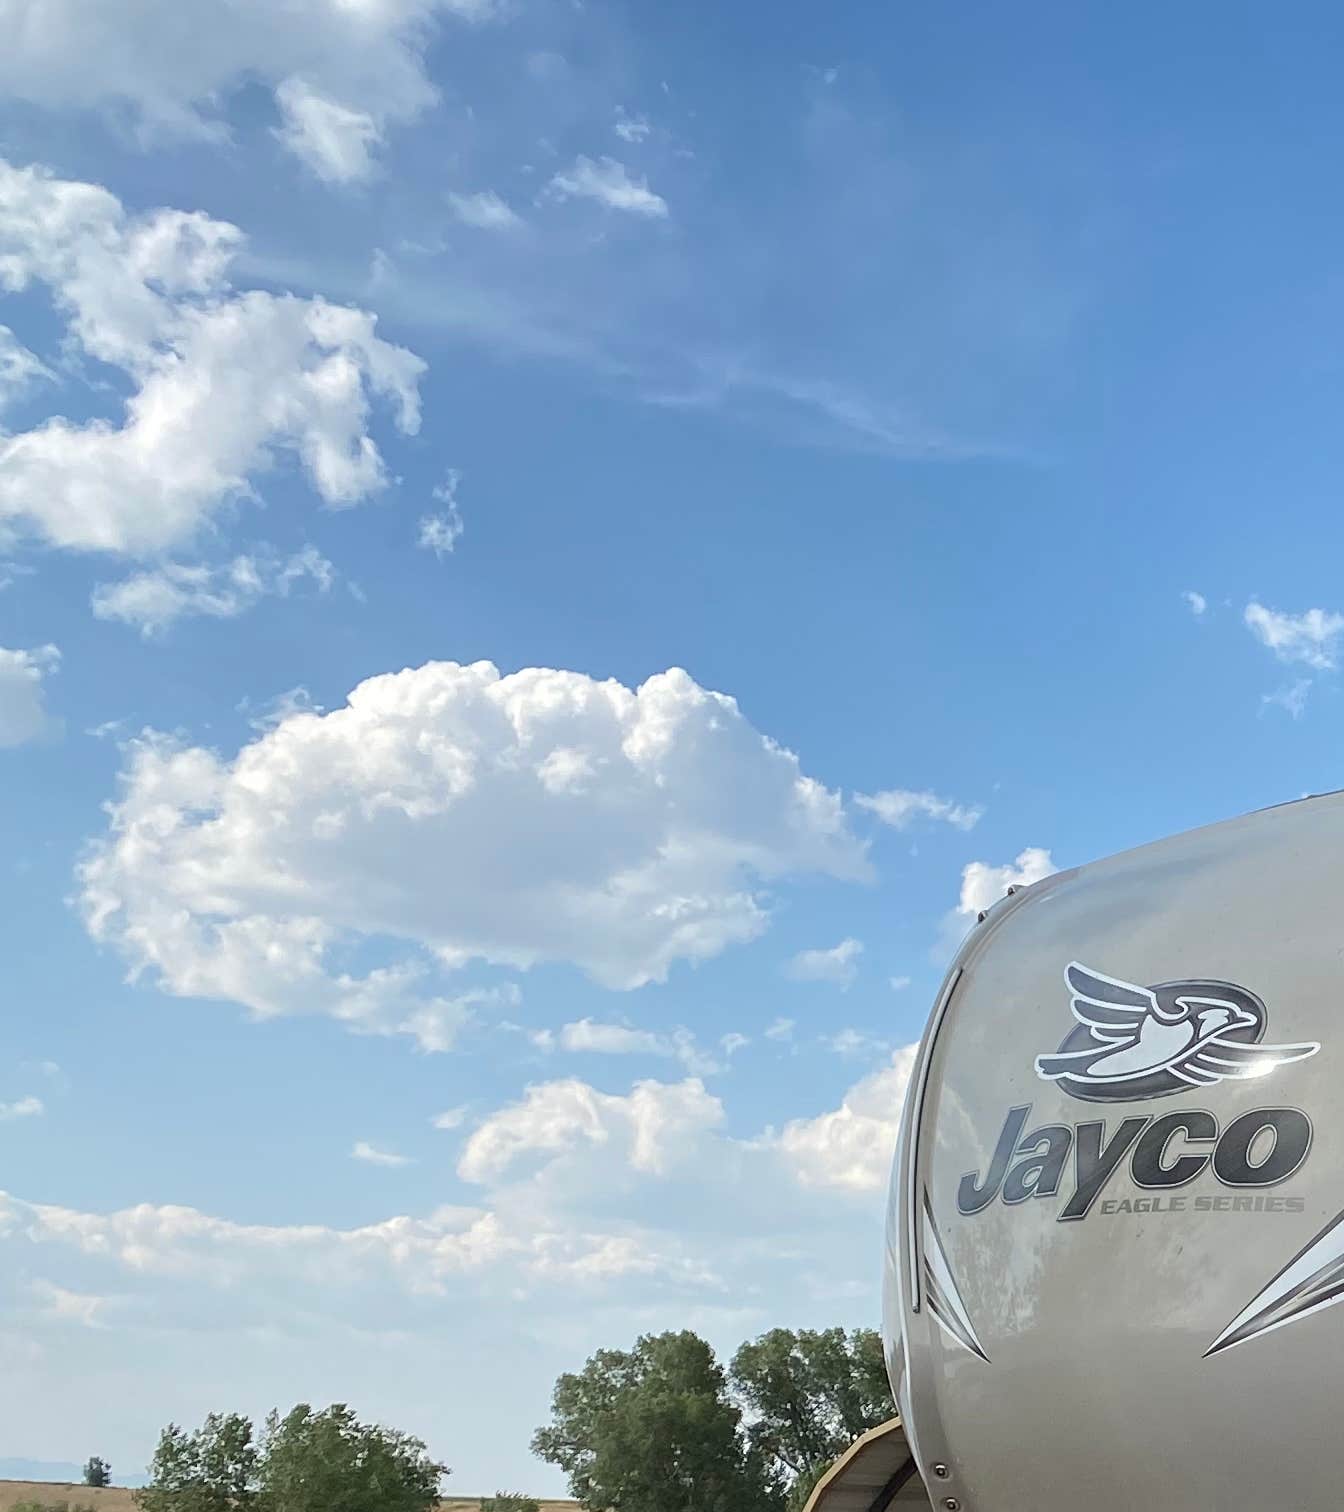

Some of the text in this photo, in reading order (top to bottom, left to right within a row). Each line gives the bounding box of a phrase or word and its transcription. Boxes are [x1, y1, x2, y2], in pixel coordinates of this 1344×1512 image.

[957, 1103, 1313, 1221] Jayco
[1100, 1196, 1305, 1215] EAGLE SERIES
